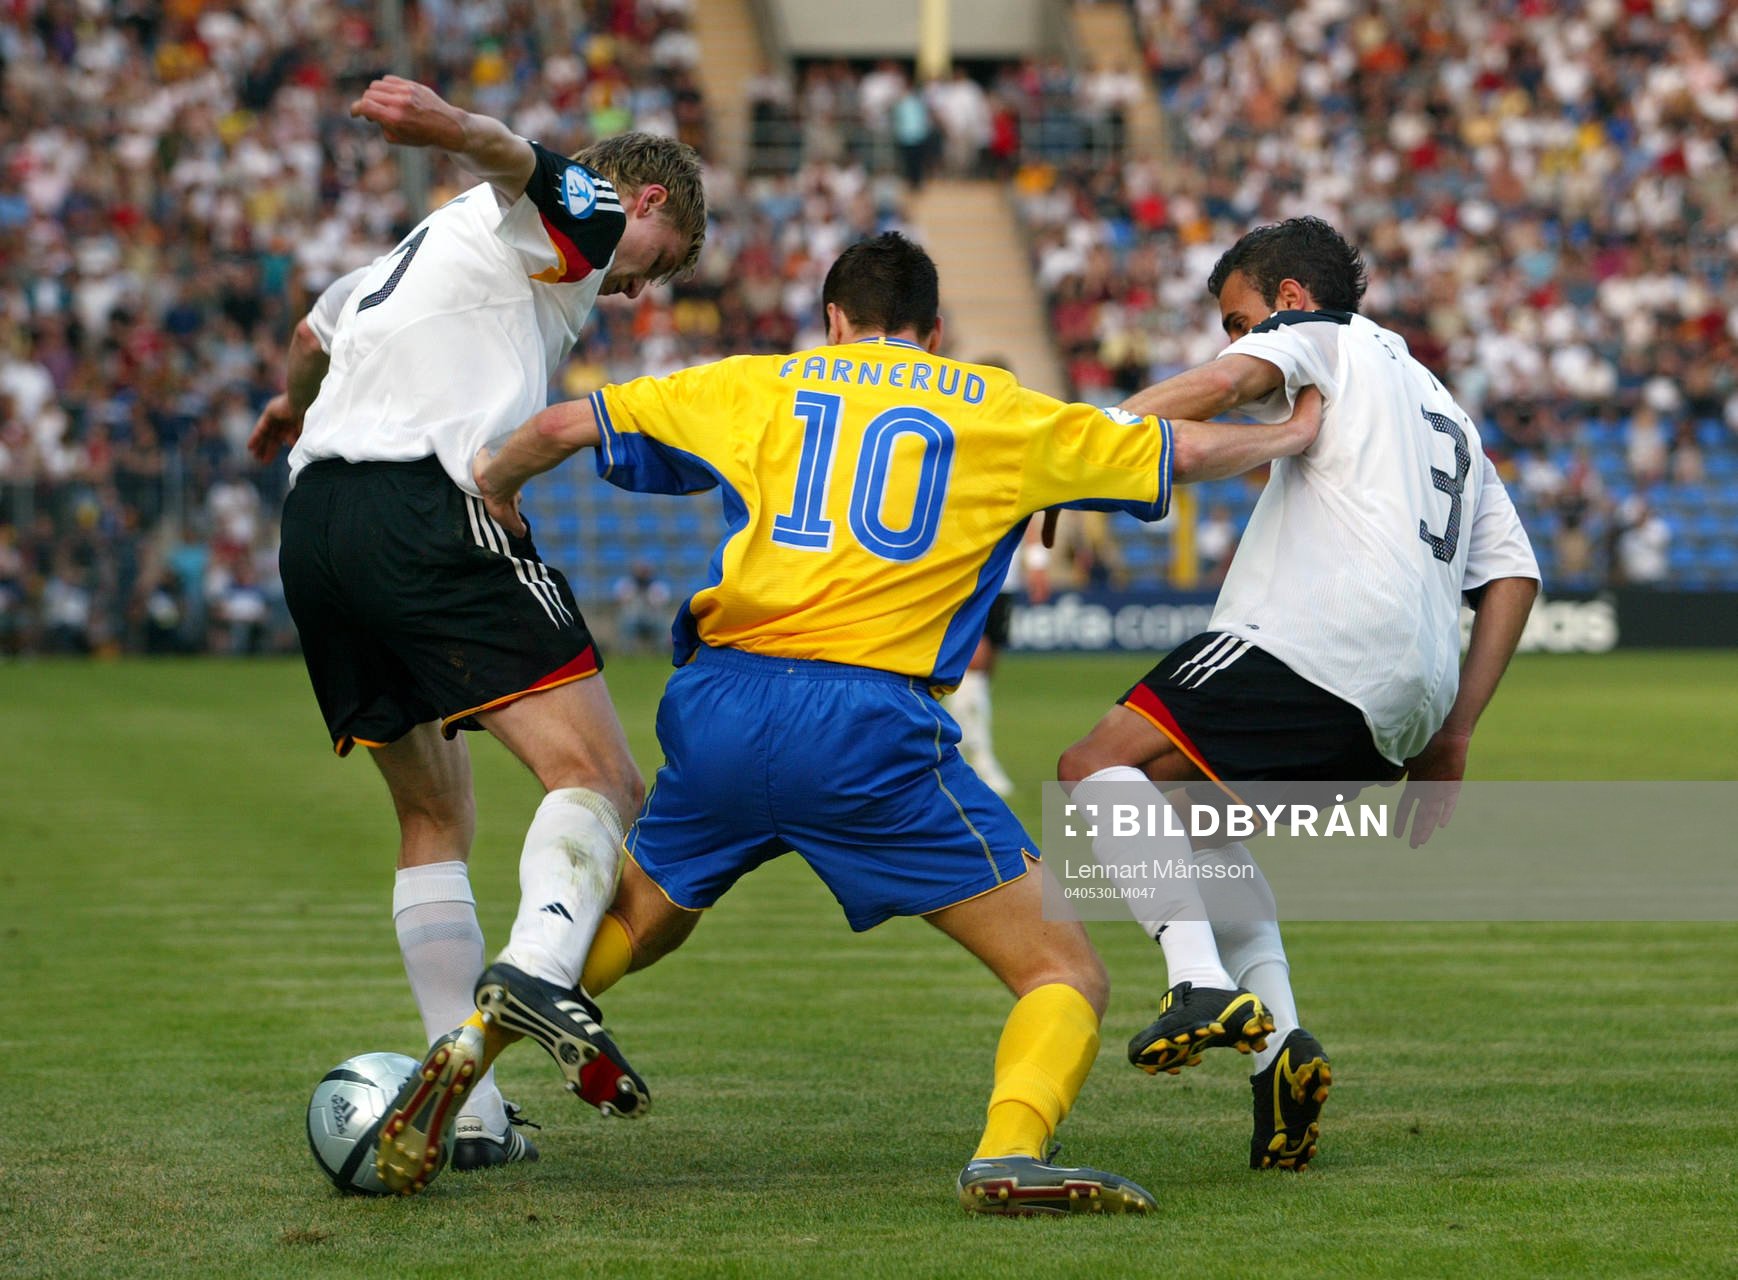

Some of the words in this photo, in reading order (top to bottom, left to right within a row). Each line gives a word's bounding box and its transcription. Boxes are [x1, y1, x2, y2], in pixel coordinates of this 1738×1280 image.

[778, 355, 986, 405] FARNERUD
[771, 390, 956, 565] 10
[1419, 403, 1471, 566] 3
